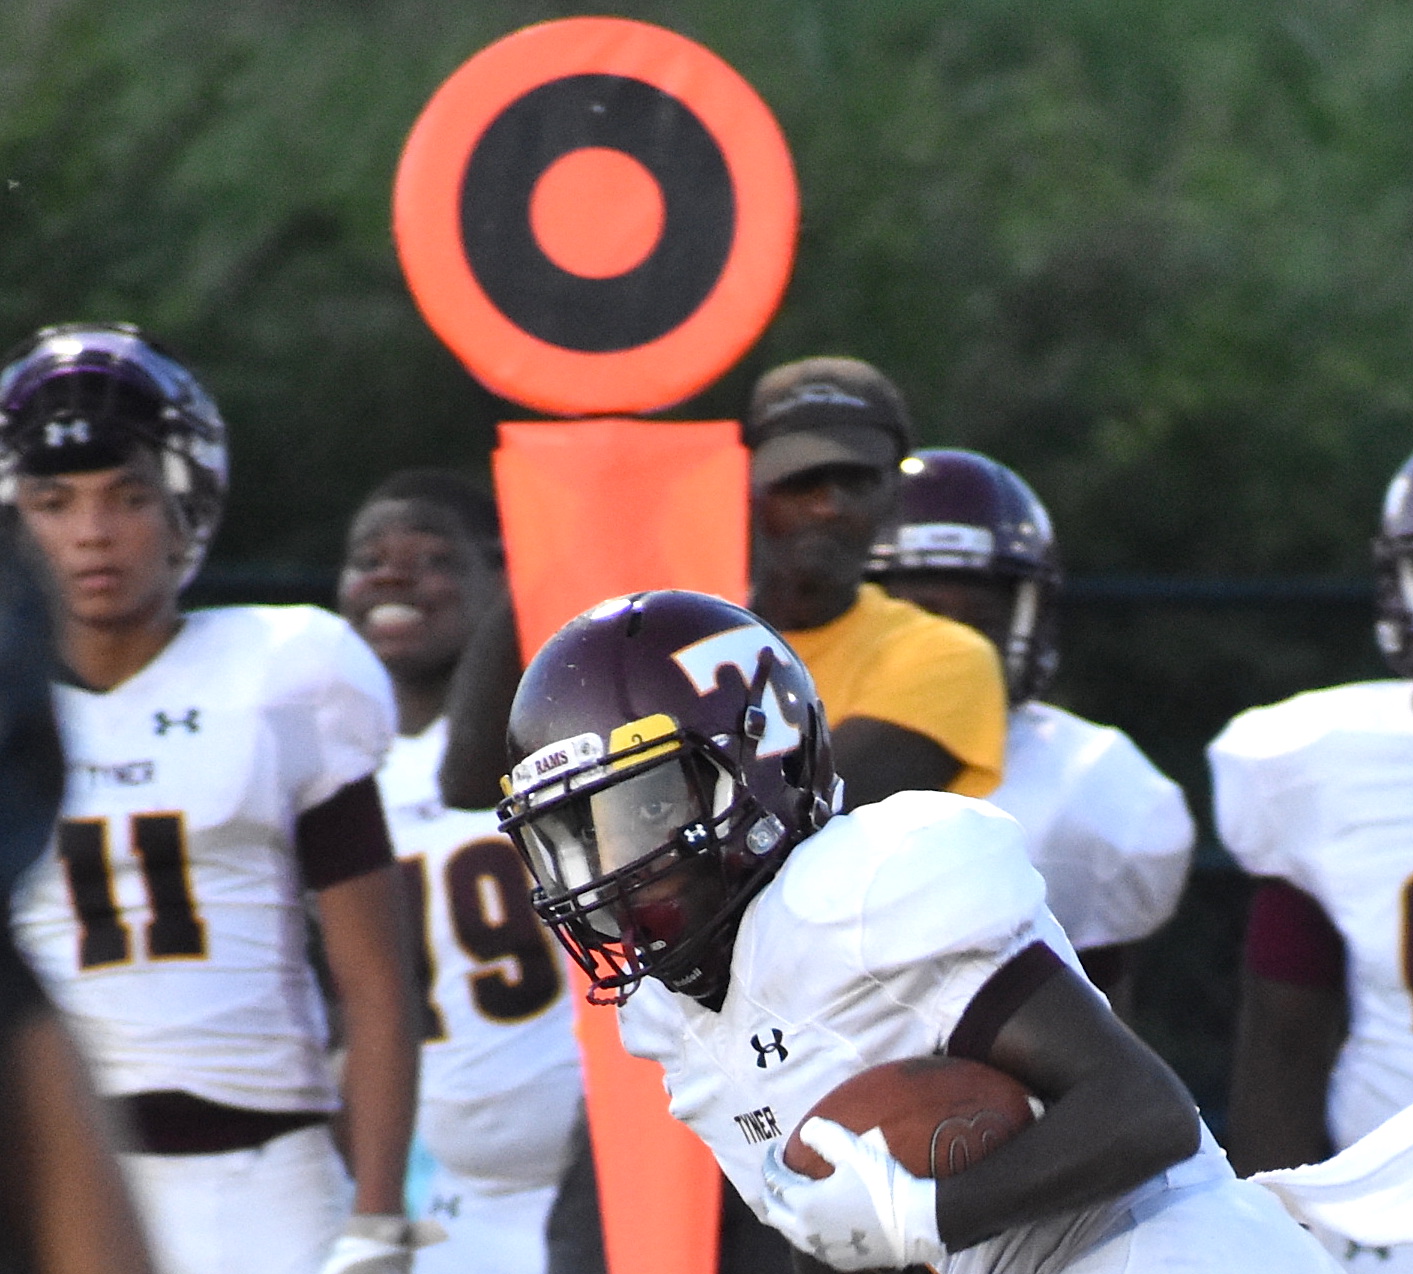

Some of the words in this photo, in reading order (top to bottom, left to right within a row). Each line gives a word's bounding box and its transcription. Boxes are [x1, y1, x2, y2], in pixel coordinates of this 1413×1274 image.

[535, 750, 569, 776] RAMS
[57, 809, 209, 971] 11
[733, 1105, 783, 1145] TYNER
